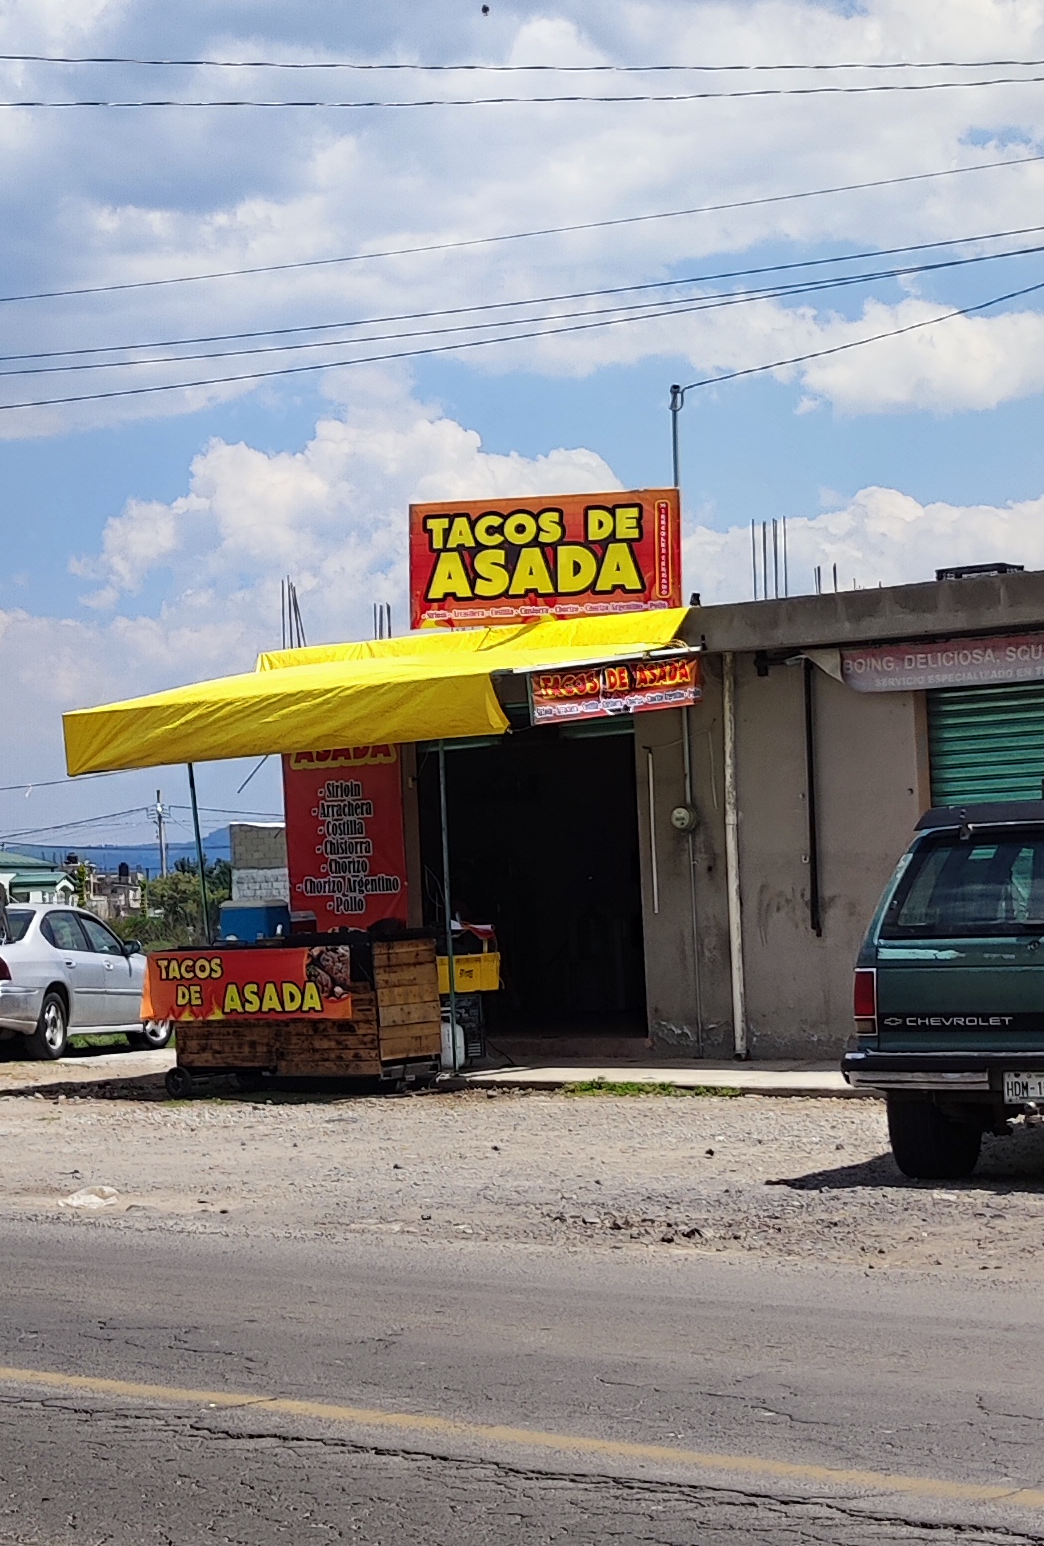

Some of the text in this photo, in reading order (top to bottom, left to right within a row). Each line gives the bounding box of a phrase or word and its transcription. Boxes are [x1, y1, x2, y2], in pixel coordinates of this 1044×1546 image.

[426, 506, 641, 550] TACOS DE
[426, 541, 644, 600] ASADA
[904, 648, 1000, 670] DELICIOSA,
[540, 660, 691, 698] TACOS DE ASADA
[324, 780, 361, 799] Sirloin
[319, 800, 373, 819] Arrachera
[325, 819, 364, 836] Costilla
[323, 839, 372, 856] Chistorra
[328, 858, 368, 875] Chorizo
[304, 875, 400, 896] Chorizo Argentino
[334, 896, 364, 913] Pollo
[157, 957, 222, 980] TACOS
[177, 981, 323, 1013] DE ASADA
[906, 1016, 1014, 1027] CHEVROLET
[1006, 1080, 1044, 1097] HDM-1
